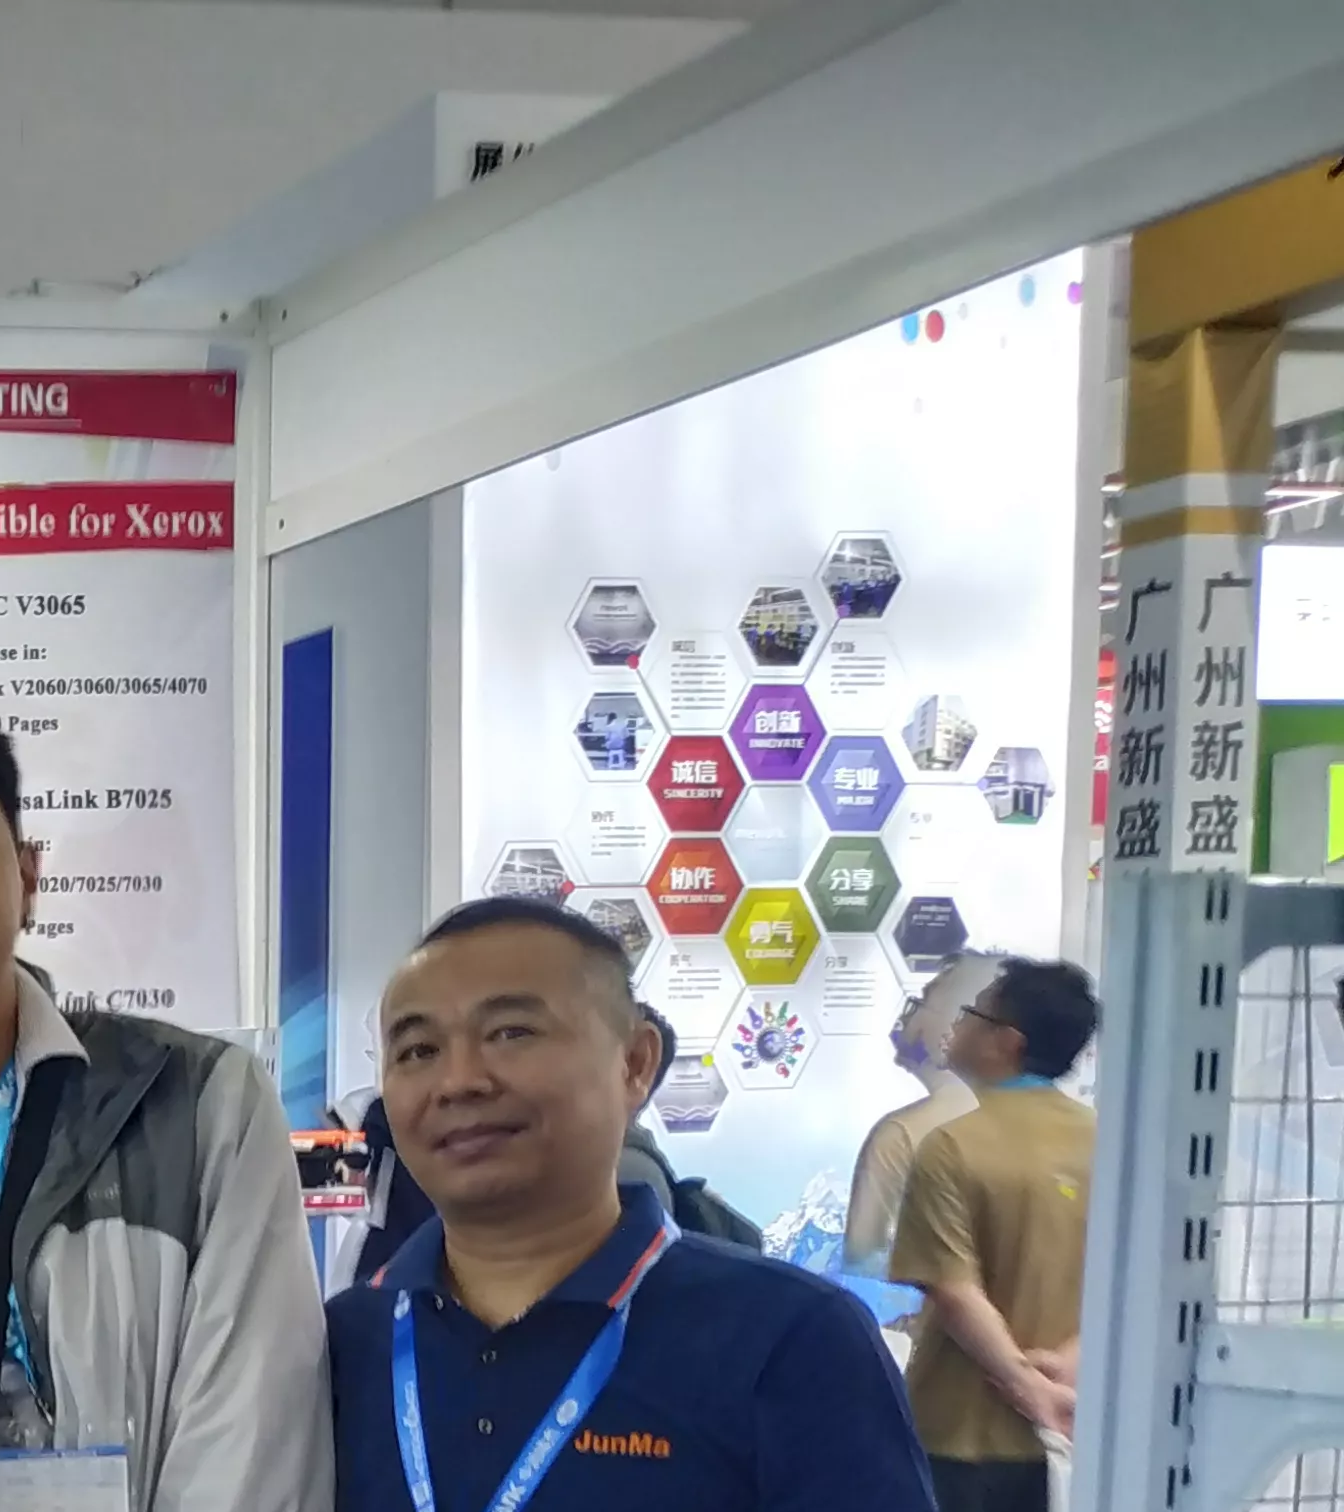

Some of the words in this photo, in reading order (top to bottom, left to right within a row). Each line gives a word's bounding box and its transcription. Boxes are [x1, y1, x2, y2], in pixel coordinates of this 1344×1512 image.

[68, 505, 115, 536] for
[125, 505, 224, 537] Xerox
[16, 596, 86, 616] V3065
[23, 645, 47, 661] in:
[12, 678, 207, 696] V2060/3060/3065/4070
[9, 716, 59, 735] Pages
[755, 711, 801, 733] 创新
[1113, 578, 1172, 876] 广州新盛
[1185, 572, 1253, 876] 广州新盛
[671, 761, 718, 783] 诚信
[834, 768, 879, 790] 专业
[17, 790, 99, 810] saLink
[105, 789, 172, 809] B7025
[36, 876, 162, 893] 020/7025/7030
[671, 867, 715, 890] 协作
[830, 869, 874, 891] 分享
[575, 1430, 671, 1458] JunMa
